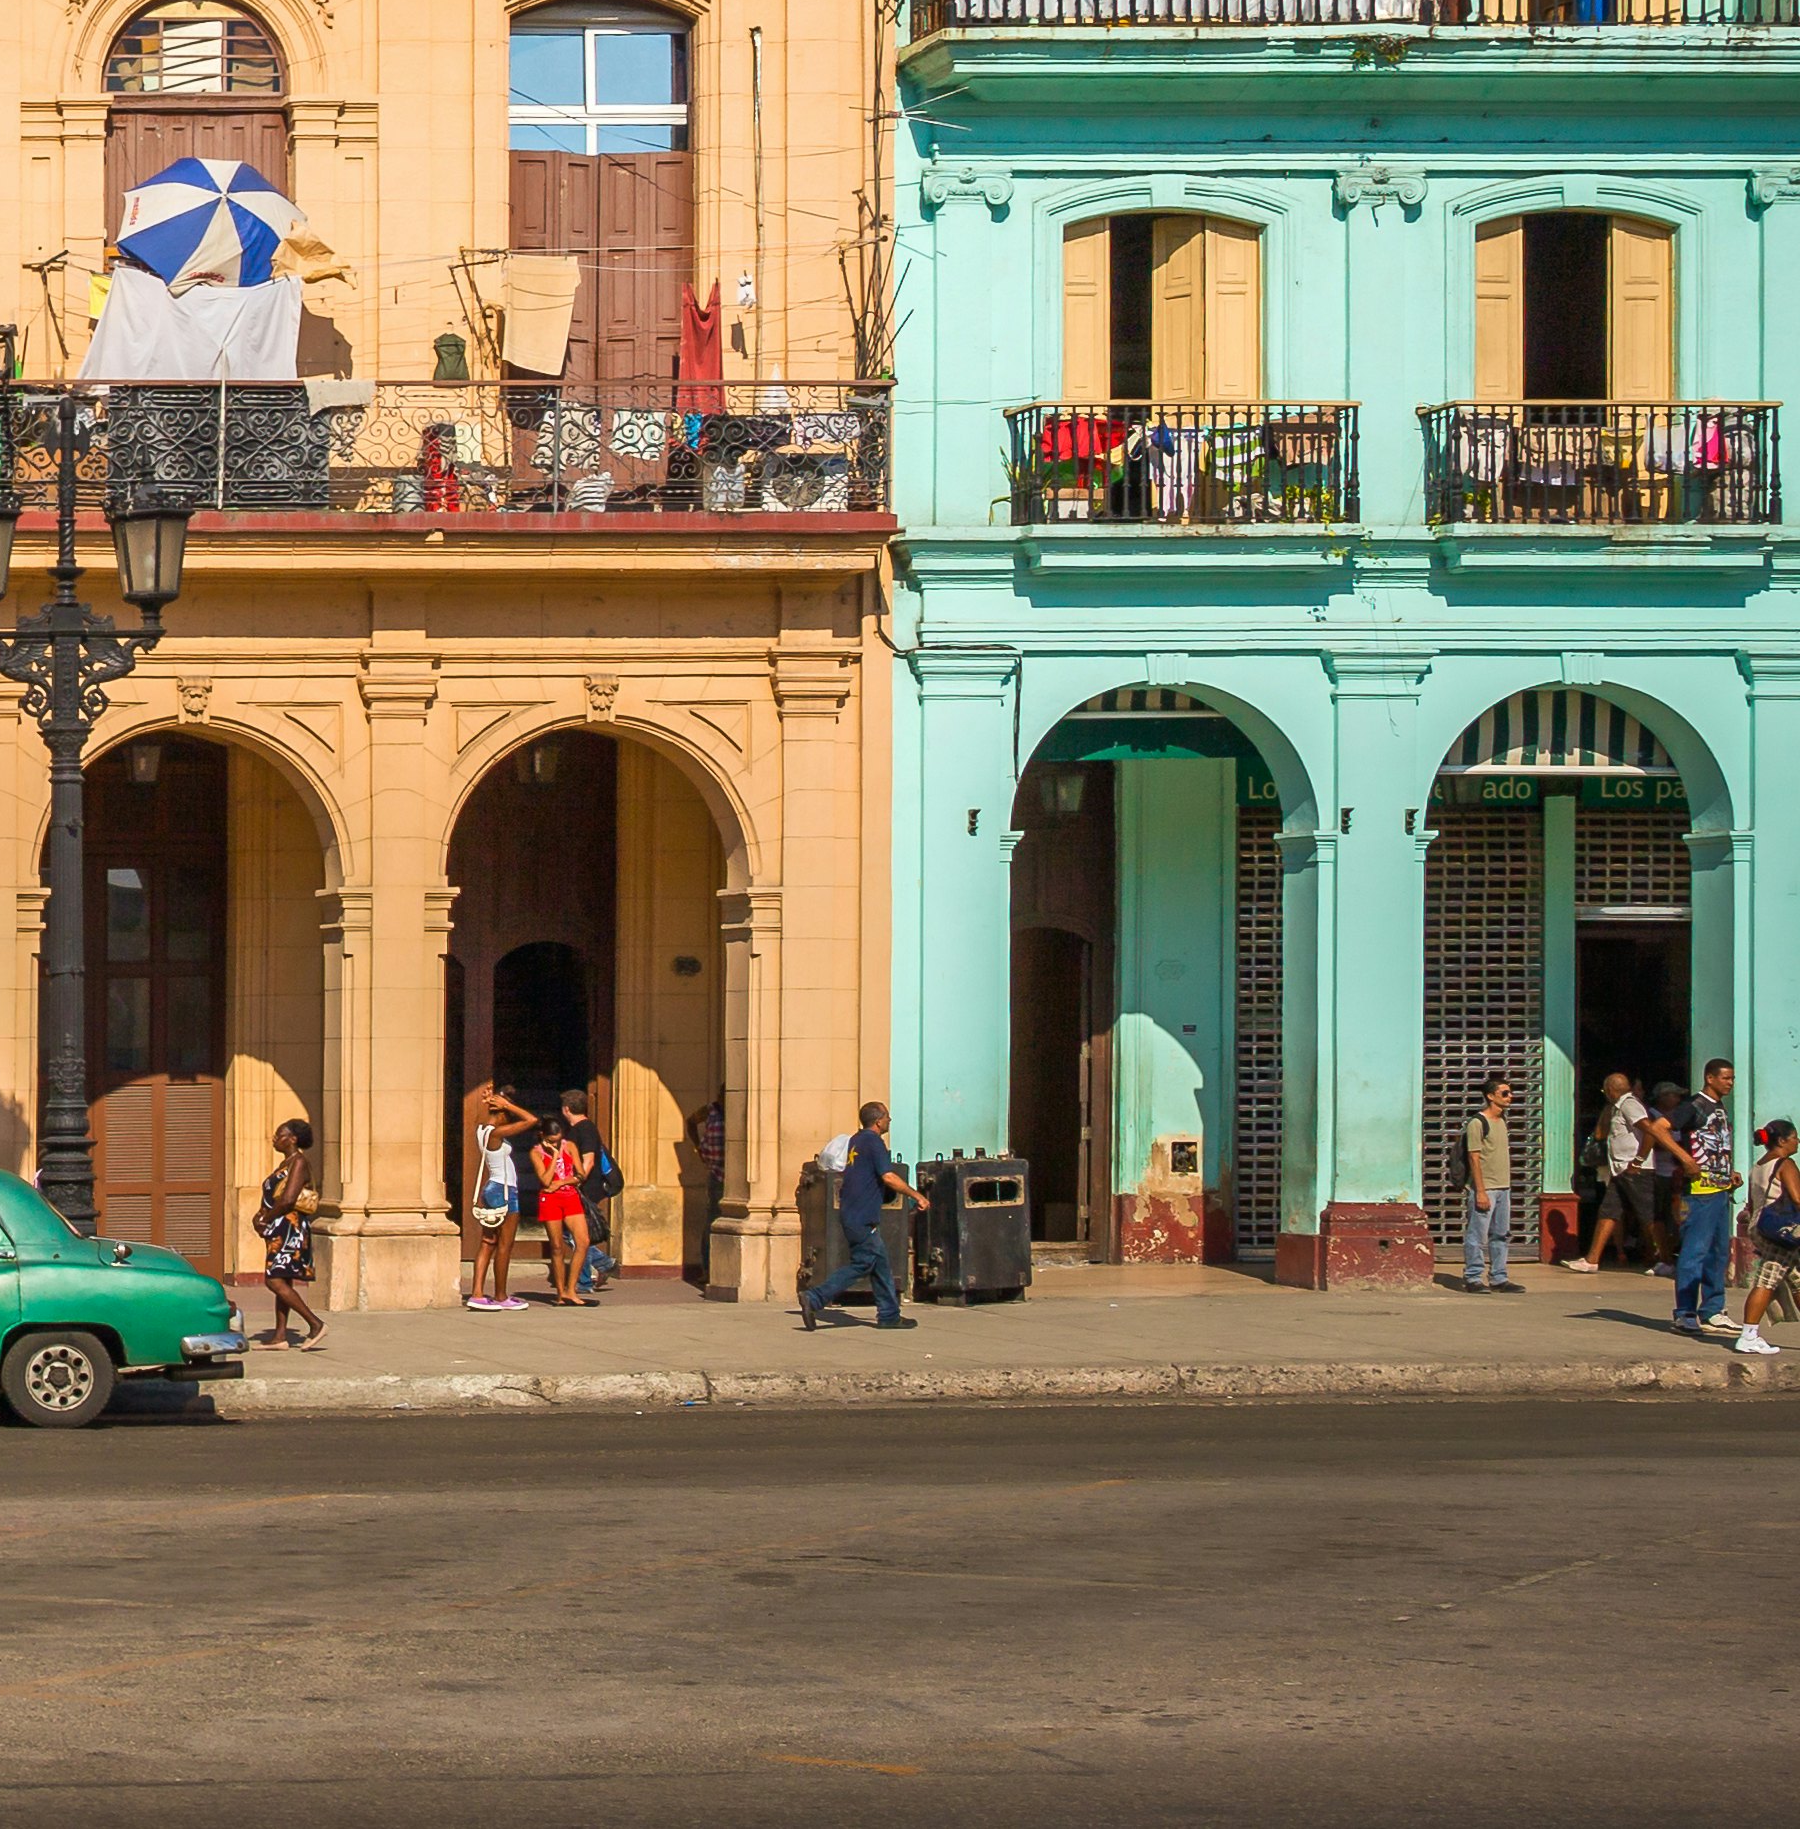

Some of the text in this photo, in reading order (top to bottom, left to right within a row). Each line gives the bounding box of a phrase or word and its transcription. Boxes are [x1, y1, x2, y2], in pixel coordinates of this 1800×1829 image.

[1248, 776, 1277, 799] Lo
[1601, 777, 1688, 804] Los pa
